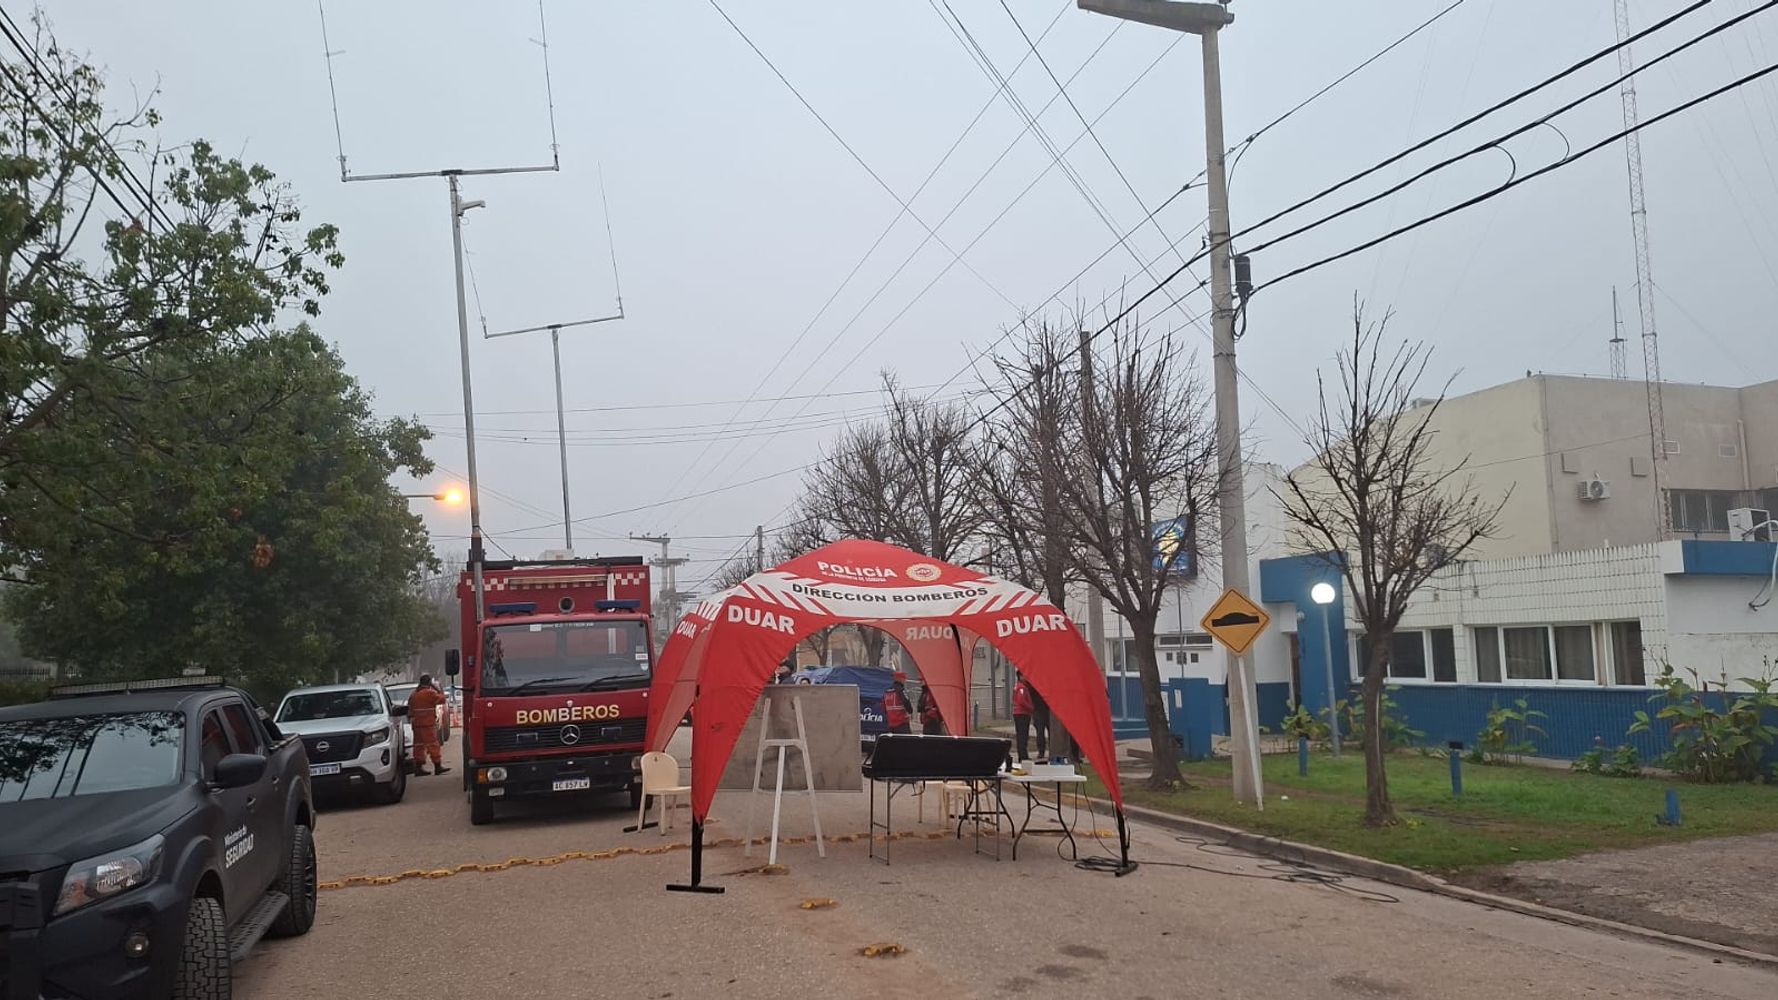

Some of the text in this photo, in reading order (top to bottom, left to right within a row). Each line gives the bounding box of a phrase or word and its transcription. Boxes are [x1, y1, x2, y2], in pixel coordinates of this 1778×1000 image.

[817, 561, 898, 578] POLICÍA
[793, 583, 989, 603] DIRECCIÓN BOMBEROS
[727, 604, 796, 636] DUAR
[995, 614, 1067, 638] DUAR
[516, 704, 620, 725] BOMBEROS
[225, 833, 254, 869] SEGURIDAD
